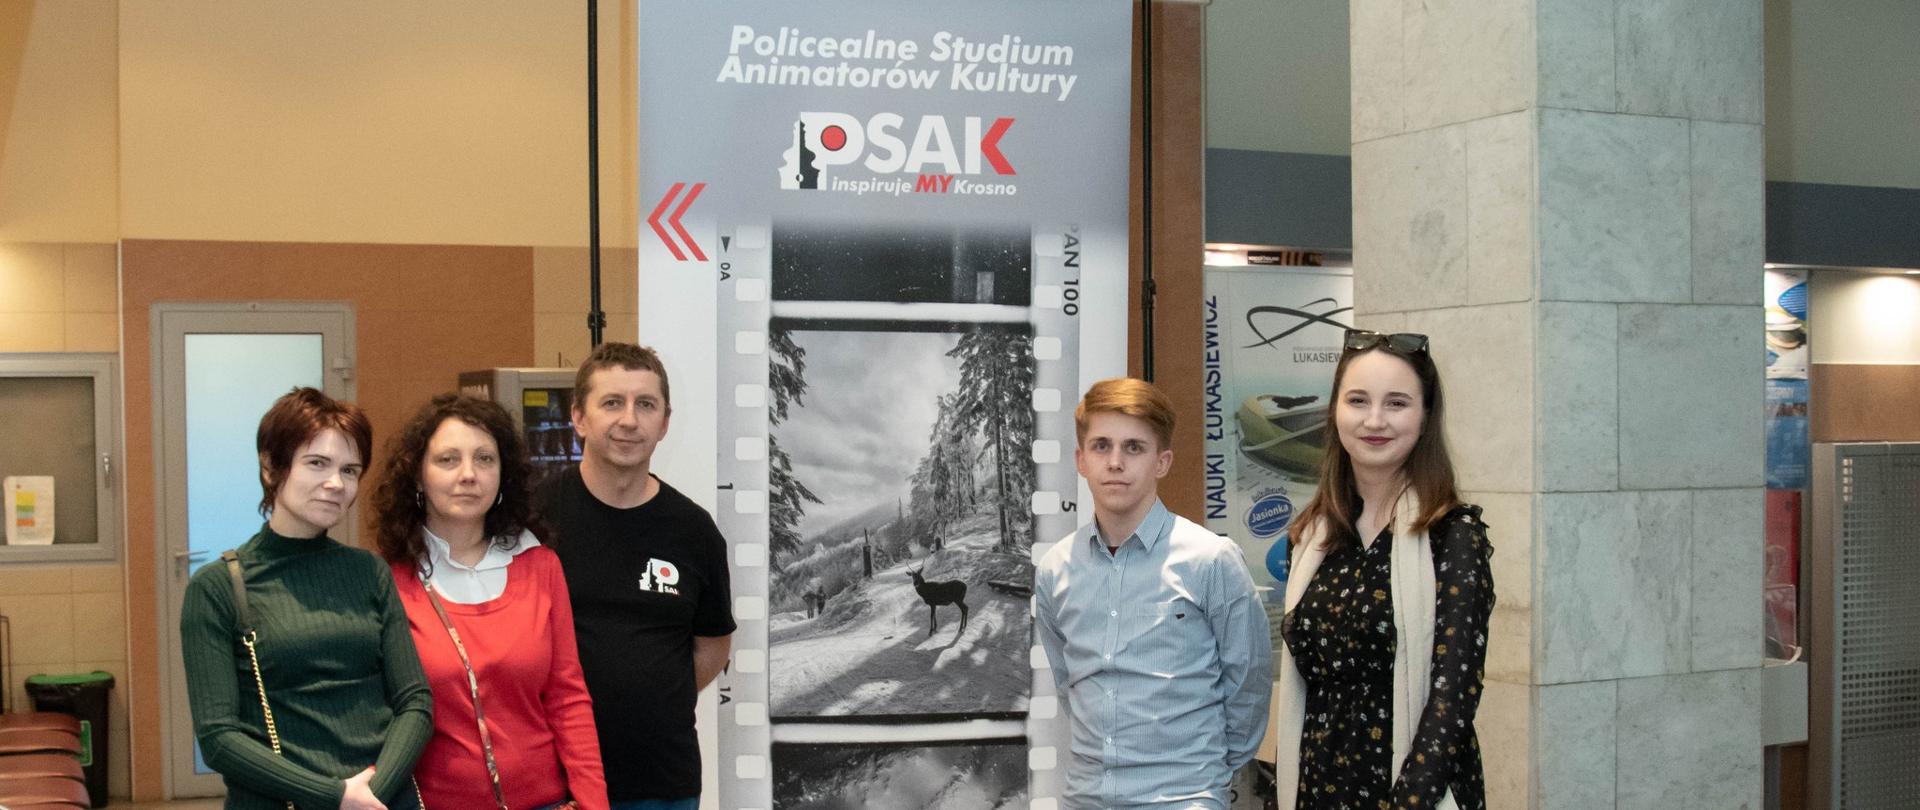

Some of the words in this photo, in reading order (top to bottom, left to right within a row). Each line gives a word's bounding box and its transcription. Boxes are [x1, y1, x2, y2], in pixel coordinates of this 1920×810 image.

[729, 25, 919, 61] Policealne
[929, 31, 1074, 66] Studium
[716, 55, 941, 90] Animatorów
[950, 62, 1078, 101] Kultury
[778, 111, 1017, 190] PSAK
[832, 176, 912, 196] inspiruje
[915, 174, 954, 193] MY
[954, 179, 1017, 196] Krosno
[1063, 279, 1079, 316] 100
[1205, 295, 1224, 441] ŁUKASIEWICZ
[717, 482, 733, 490] 1
[1206, 454, 1227, 519] NAUKI
[1061, 500, 1077, 512] 5
[1251, 503, 1289, 523] Jasionka
[719, 686, 731, 705] 1A
